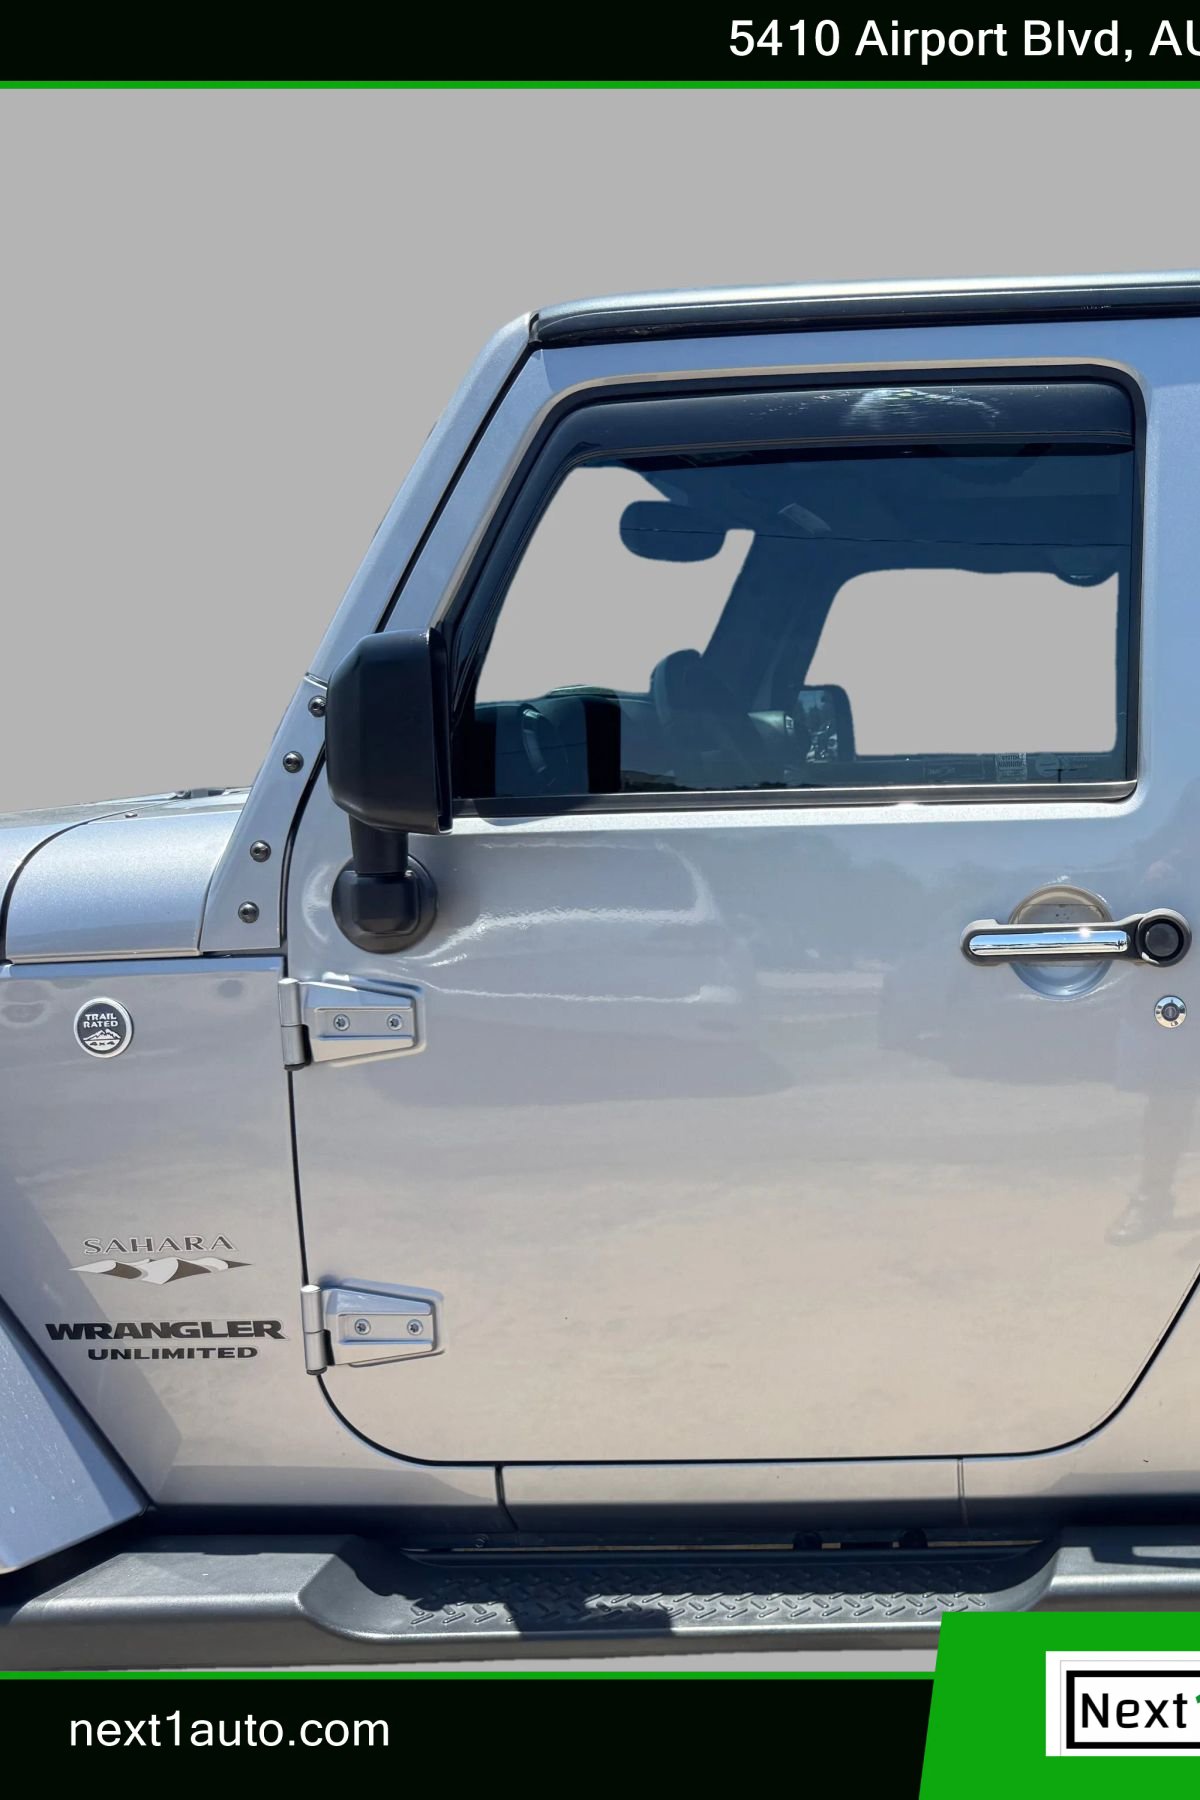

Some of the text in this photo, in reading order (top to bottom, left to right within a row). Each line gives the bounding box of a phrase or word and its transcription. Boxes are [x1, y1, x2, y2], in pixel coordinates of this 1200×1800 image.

[83, 1020, 119, 1029] RATED
[84, 1012, 117, 1021] TRAIL
[83, 1235, 238, 1255] SAHARA
[45, 1319, 287, 1341] WRANGLER
[87, 1345, 259, 1361] UNLIMITED
